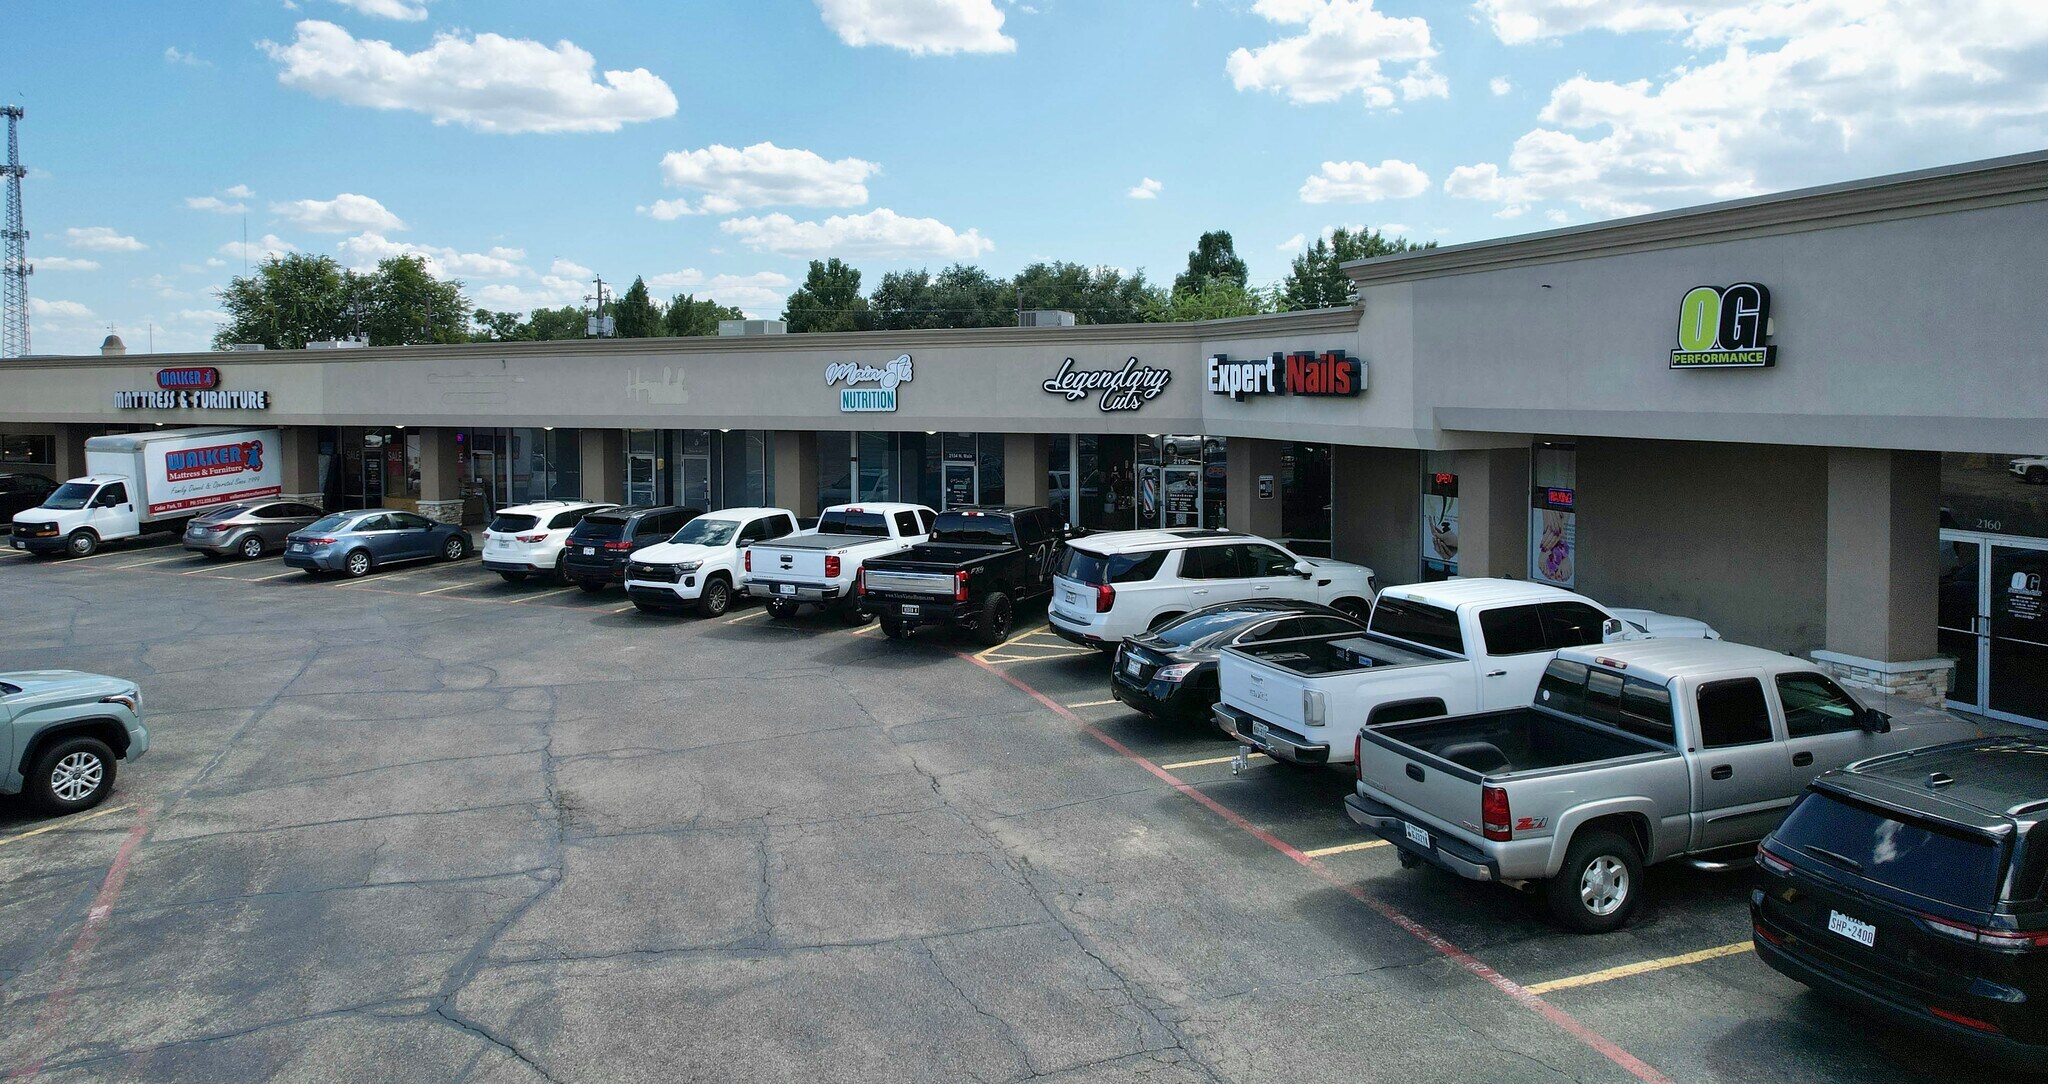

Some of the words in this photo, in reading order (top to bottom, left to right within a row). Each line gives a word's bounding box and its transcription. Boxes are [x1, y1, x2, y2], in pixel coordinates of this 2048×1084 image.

[1679, 283, 1761, 351] OG
[1673, 352, 1764, 364] PERFORMANCE
[160, 370, 202, 386] WALKER
[825, 361, 882, 386] Main
[1043, 358, 1170, 400] Legendary
[1207, 356, 1276, 399] Expert
[1286, 353, 1352, 394] Nails
[114, 390, 176, 409] MATTRESS
[179, 391, 189, 409] &
[193, 390, 265, 409] FURNITURE
[843, 391, 894, 409] NUTRITION
[1100, 385, 1141, 411] Cuts
[167, 446, 242, 471] WALKER
[388, 451, 402, 462] SALE
[168, 470, 201, 480] Mattress
[201, 468, 209, 476] &
[209, 465, 243, 475] Furniture
[1436, 473, 1453, 484] OPEN
[1976, 518, 2001, 530] 2160
[1515, 816, 1549, 830] Z71
